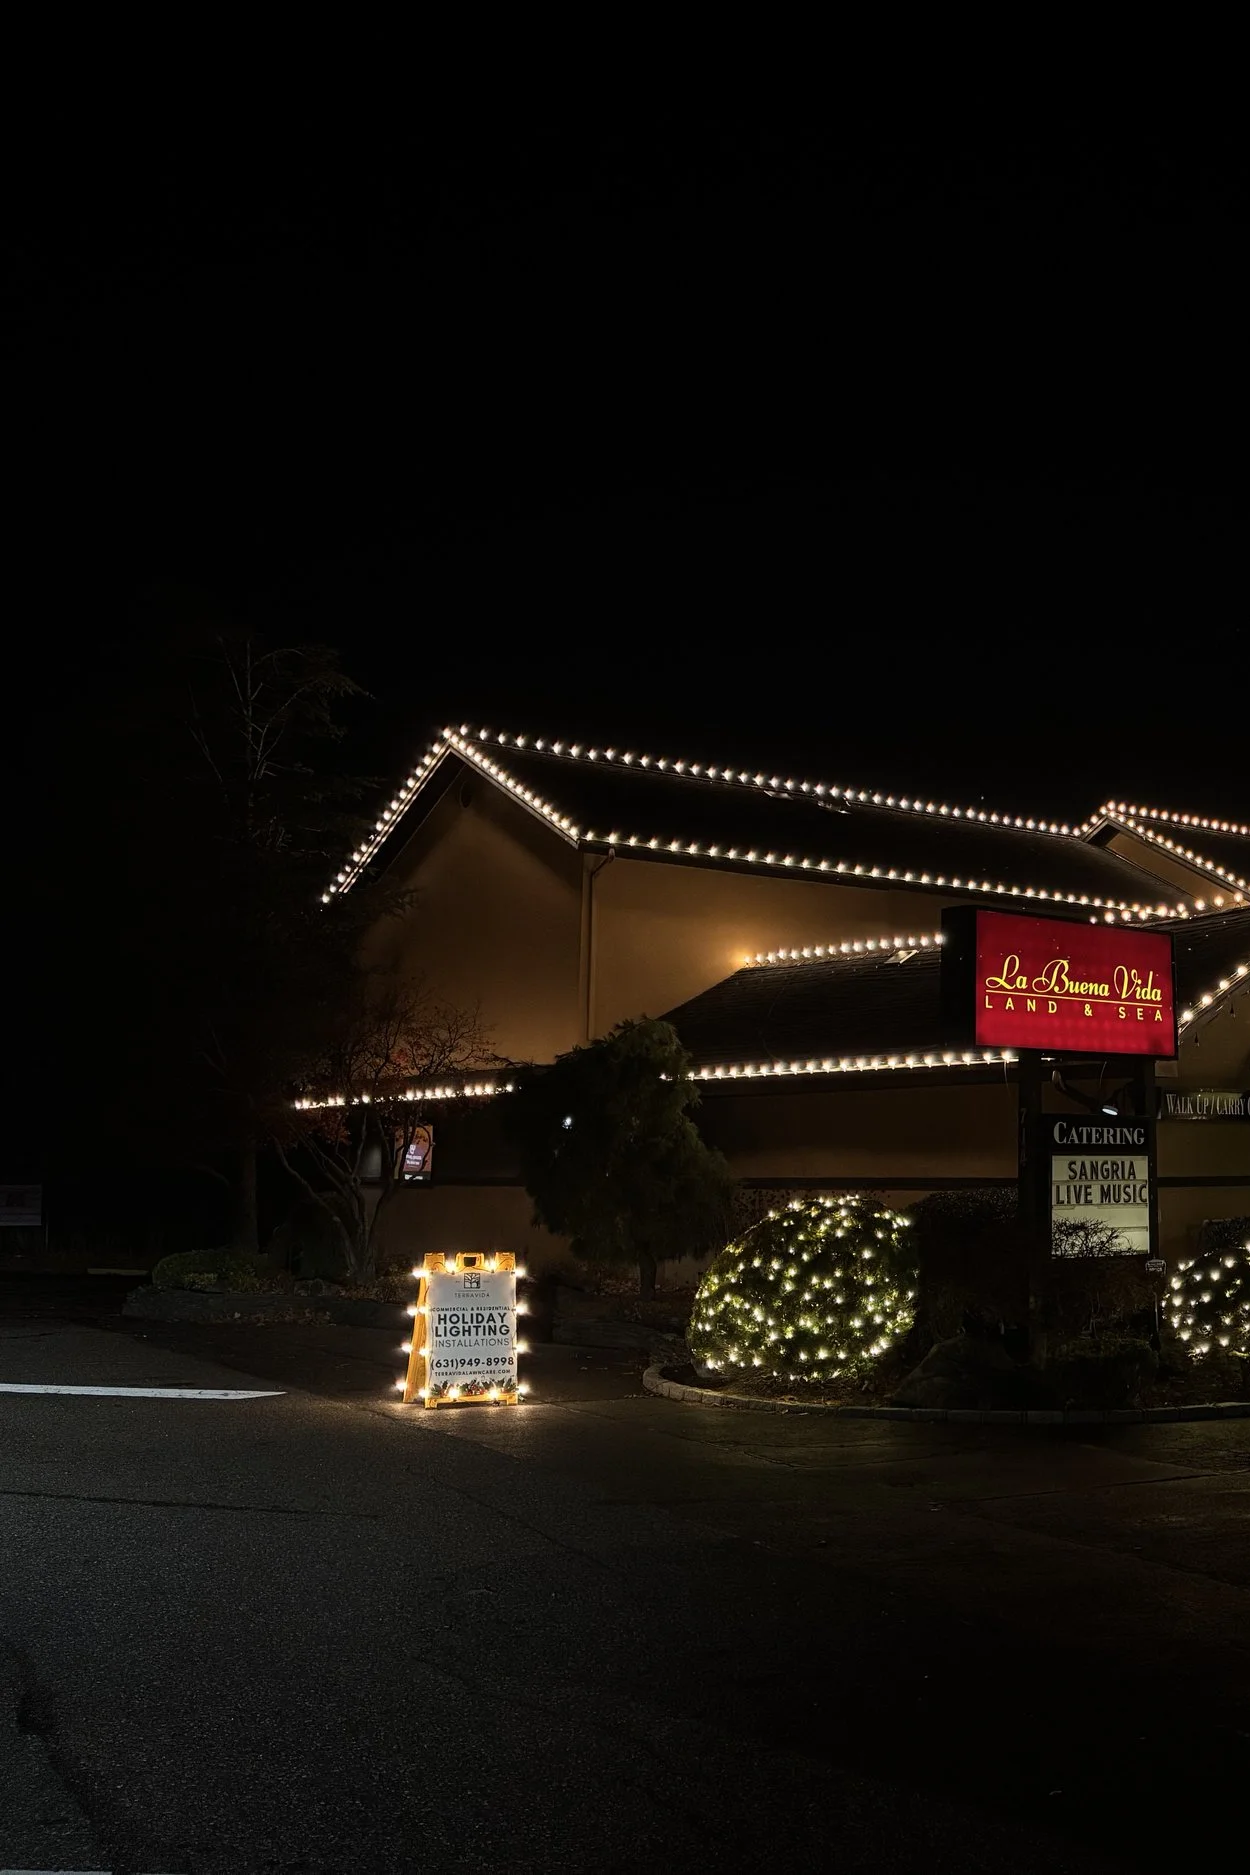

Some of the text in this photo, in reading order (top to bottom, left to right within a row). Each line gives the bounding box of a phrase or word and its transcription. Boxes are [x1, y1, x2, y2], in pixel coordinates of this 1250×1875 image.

[985, 954, 1162, 1001] La Buena Vida
[985, 995, 1163, 1022] LAND & SEA
[1165, 1093, 1194, 1115] WALK
[1053, 1121, 1145, 1146] CATERING
[1067, 1160, 1136, 1181] SANGRIA
[1055, 1183, 1147, 1205] LIVE MUSIC
[437, 1312, 507, 1325] HOLIDAY
[434, 1324, 510, 1338] LIGHTING
[435, 1337, 510, 1348] INSTALLATIONS
[431, 1356, 514, 1371] (631)949-8998
